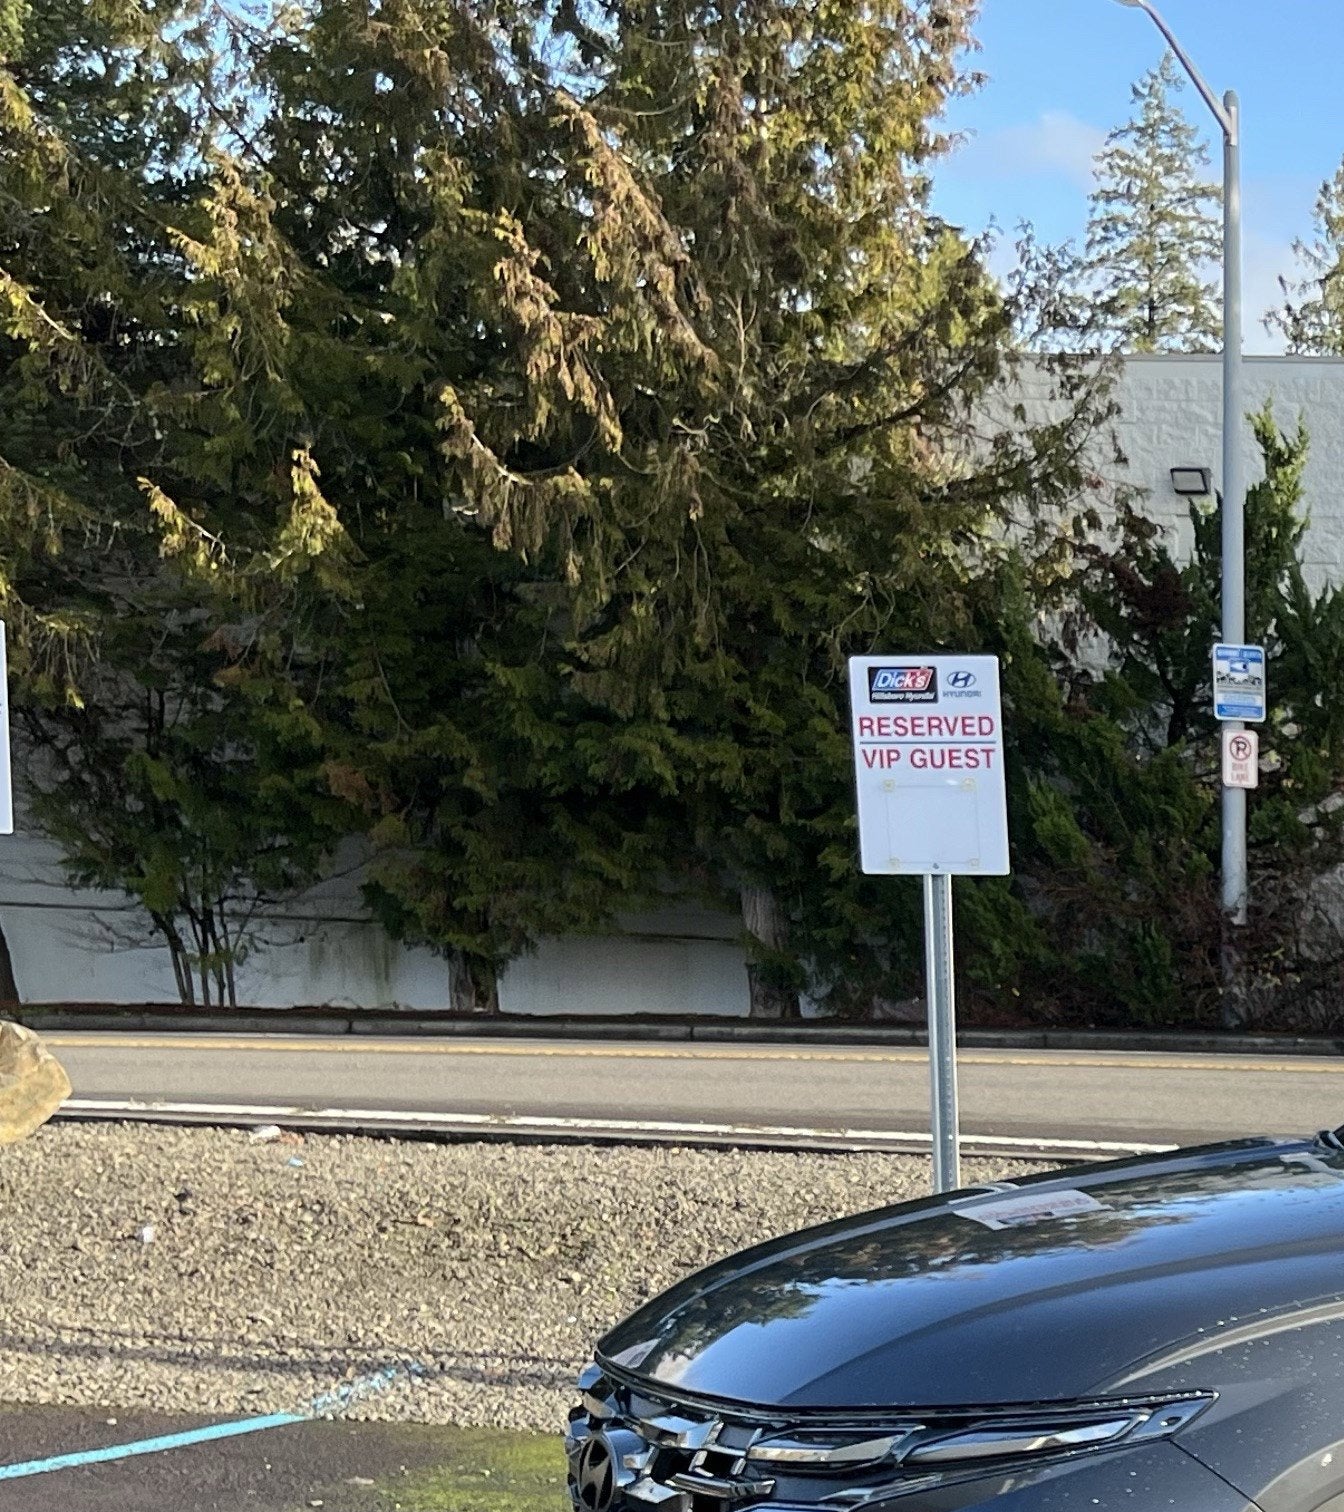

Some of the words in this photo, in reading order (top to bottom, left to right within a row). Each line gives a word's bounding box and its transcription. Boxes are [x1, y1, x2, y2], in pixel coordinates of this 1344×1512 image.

[858, 715, 995, 737] RESERVED
[861, 748, 902, 769] VIP
[909, 748, 996, 769] GUEST
